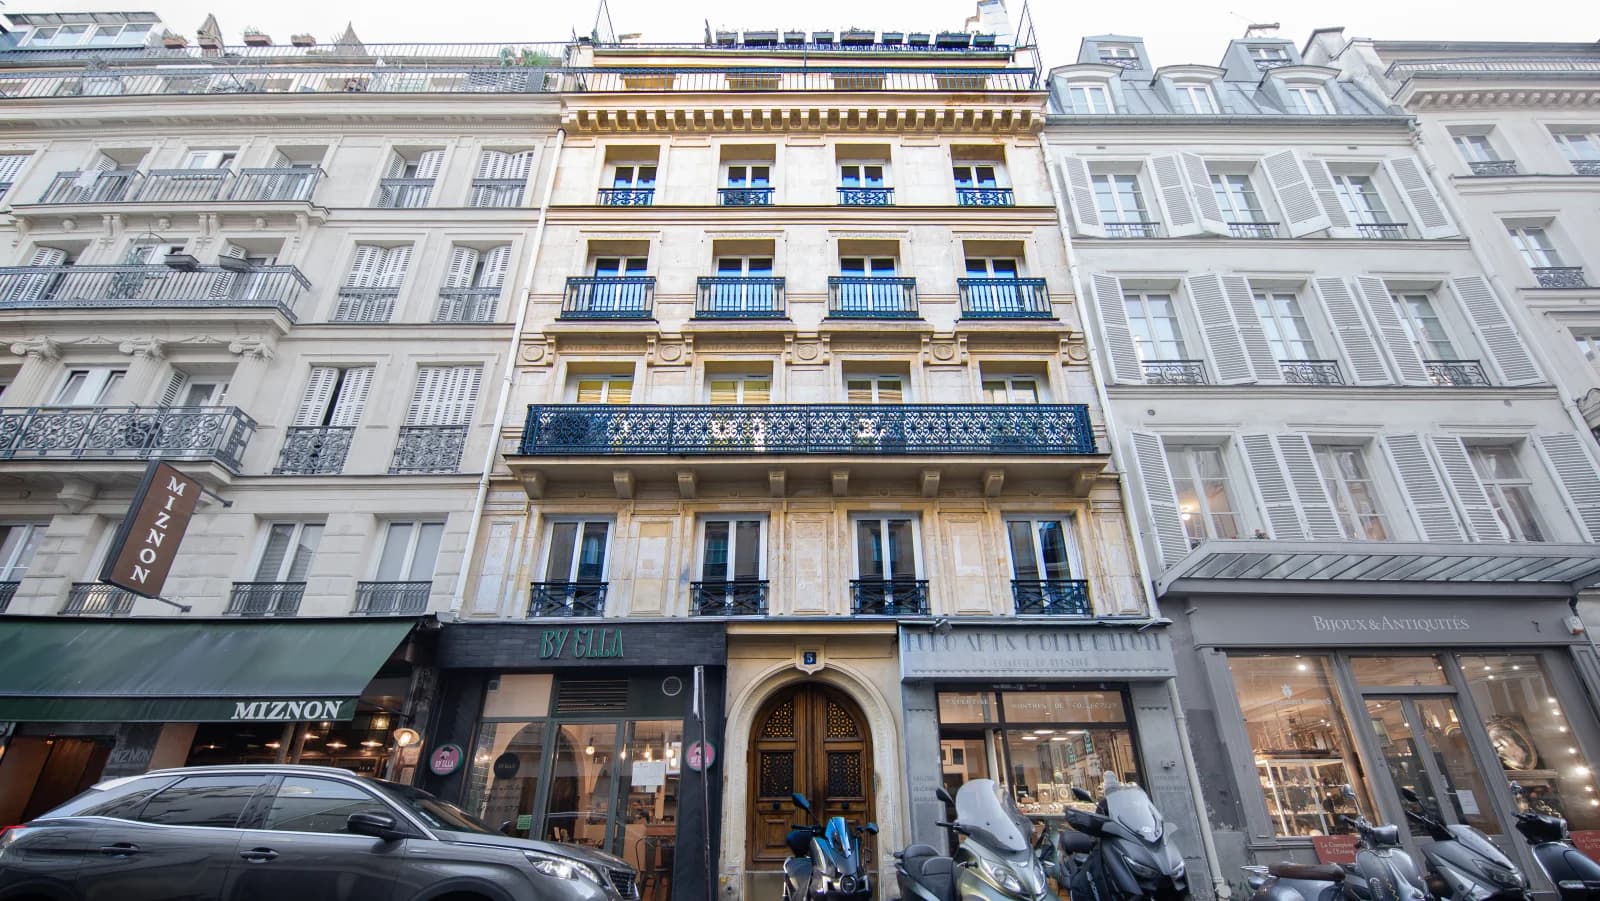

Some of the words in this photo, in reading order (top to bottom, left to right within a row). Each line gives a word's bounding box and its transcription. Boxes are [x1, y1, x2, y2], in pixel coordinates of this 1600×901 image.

[129, 476, 186, 585] MIZNON
[539, 629, 569, 659] BY
[571, 627, 624, 659] ELLA
[806, 653, 813, 663] 5
[230, 700, 343, 720] MIZNON
